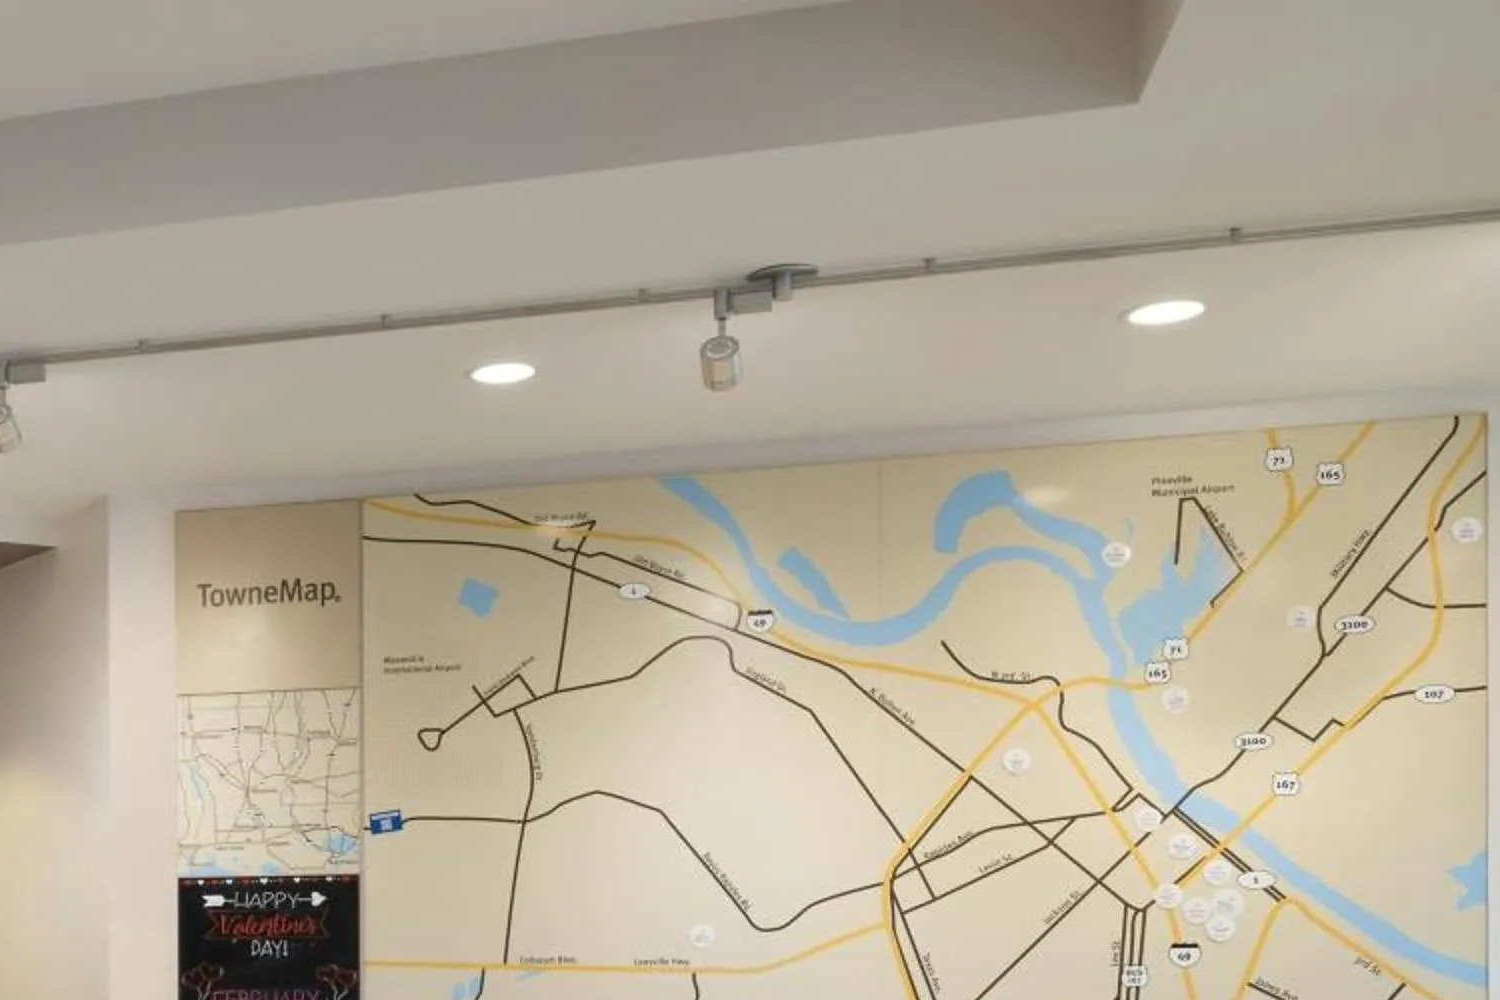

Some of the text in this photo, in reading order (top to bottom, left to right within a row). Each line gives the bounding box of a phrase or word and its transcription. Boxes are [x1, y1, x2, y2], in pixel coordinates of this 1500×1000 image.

[1319, 469, 1341, 481] 165
[1201, 484, 1236, 494] Airport
[1341, 619, 1369, 630] 3100
[1149, 668, 1168, 679] 165
[1424, 690, 1445, 699] 107
[1276, 780, 1296, 791] 167
[234, 891, 300, 909] HAPPY
[250, 939, 289, 957] DAY!
